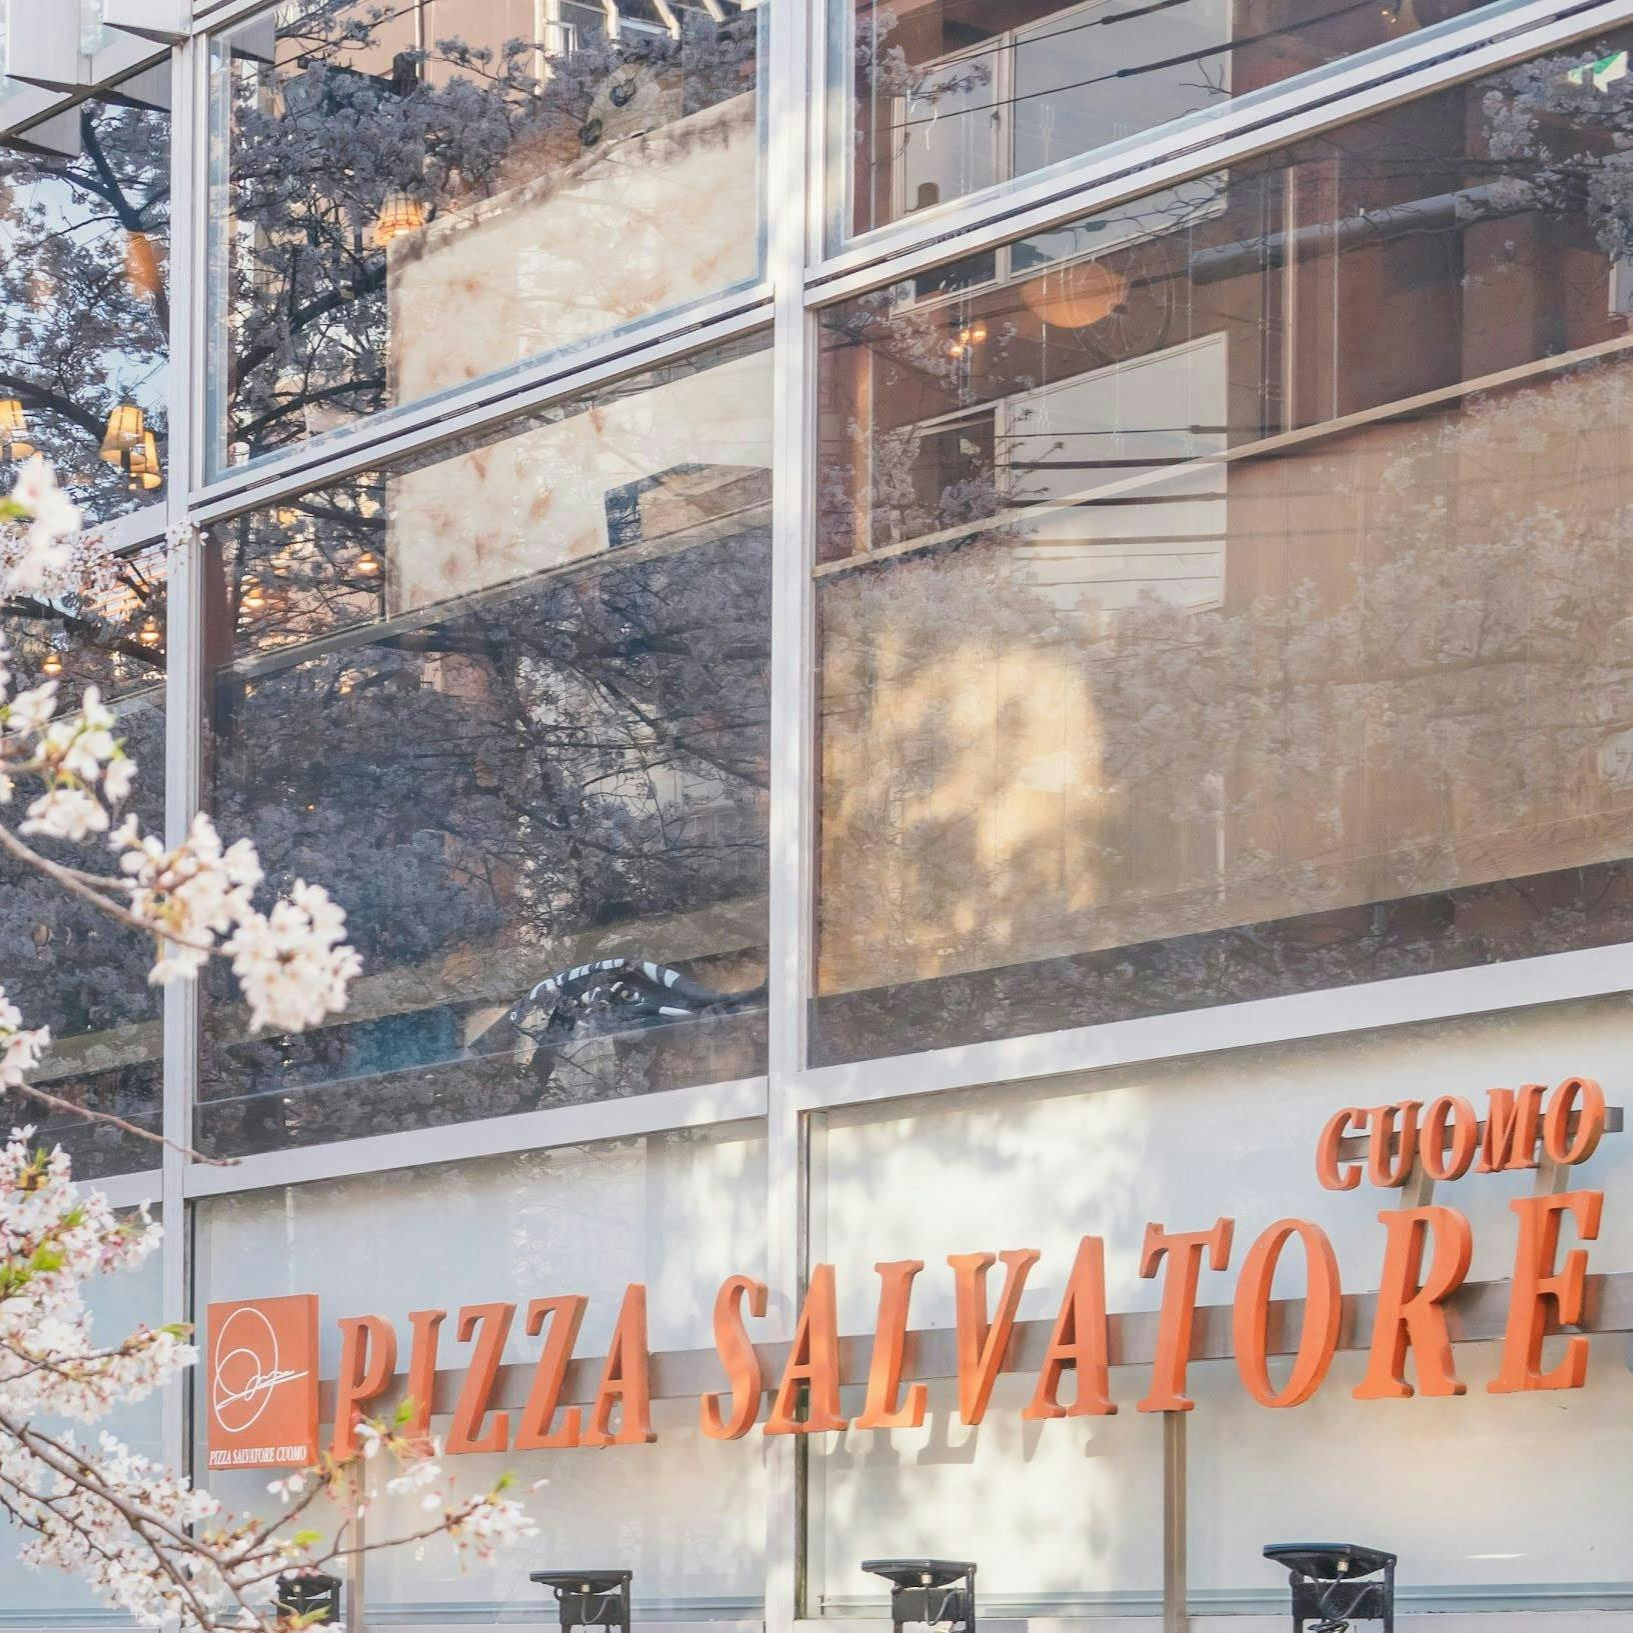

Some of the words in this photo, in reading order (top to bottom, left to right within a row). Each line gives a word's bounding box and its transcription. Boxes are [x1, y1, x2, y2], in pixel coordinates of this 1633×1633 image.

[1316, 1077, 1606, 1191] CUOMO
[332, 1283, 657, 1462] PIZZA
[701, 1190, 1604, 1440] SALVATORE
[209, 1450, 231, 1465] PIZZA
[232, 1447, 275, 1464] SALVATORE
[276, 1445, 307, 1462] CUOMO
